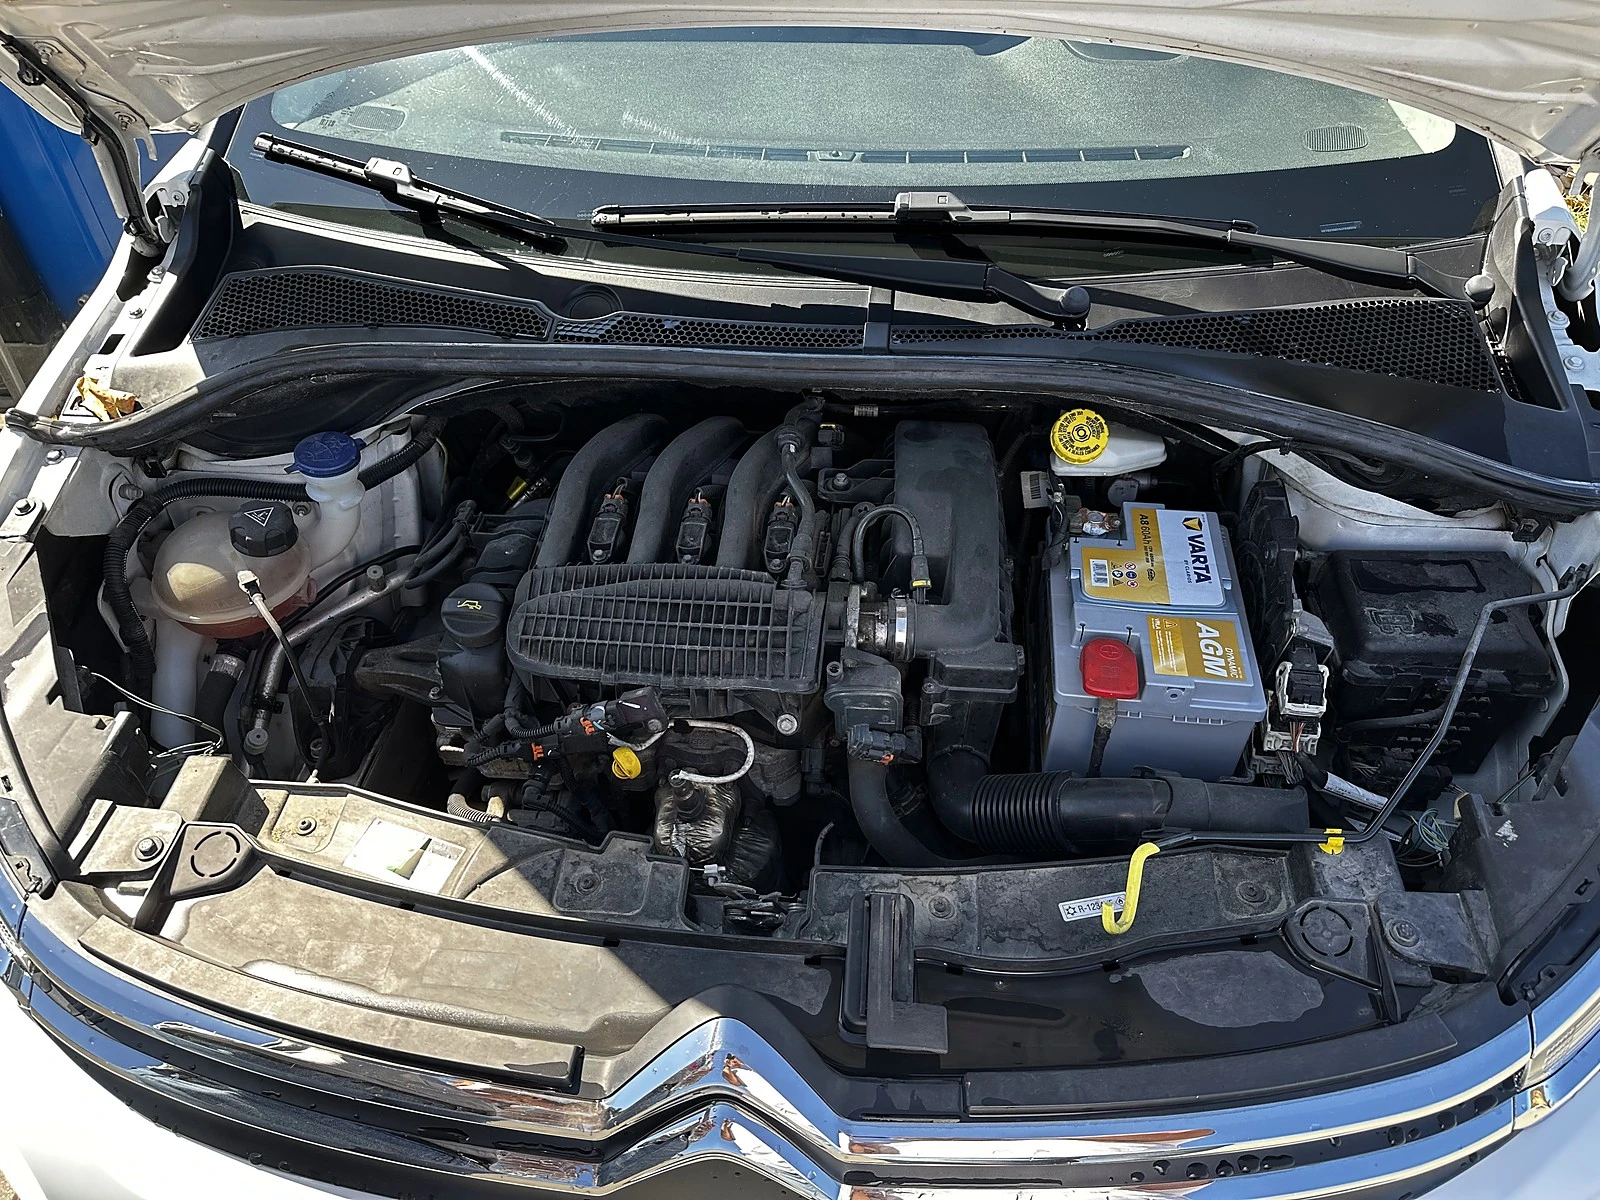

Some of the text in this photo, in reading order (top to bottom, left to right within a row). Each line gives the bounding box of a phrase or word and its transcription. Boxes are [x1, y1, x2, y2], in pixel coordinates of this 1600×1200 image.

[1139, 514, 1149, 525] A8
[1140, 526, 1152, 545] 60Ah
[1187, 534, 1211, 584] VARTA
[1195, 621, 1228, 678] AGM
[1224, 647, 1238, 679] DYNAMIC
